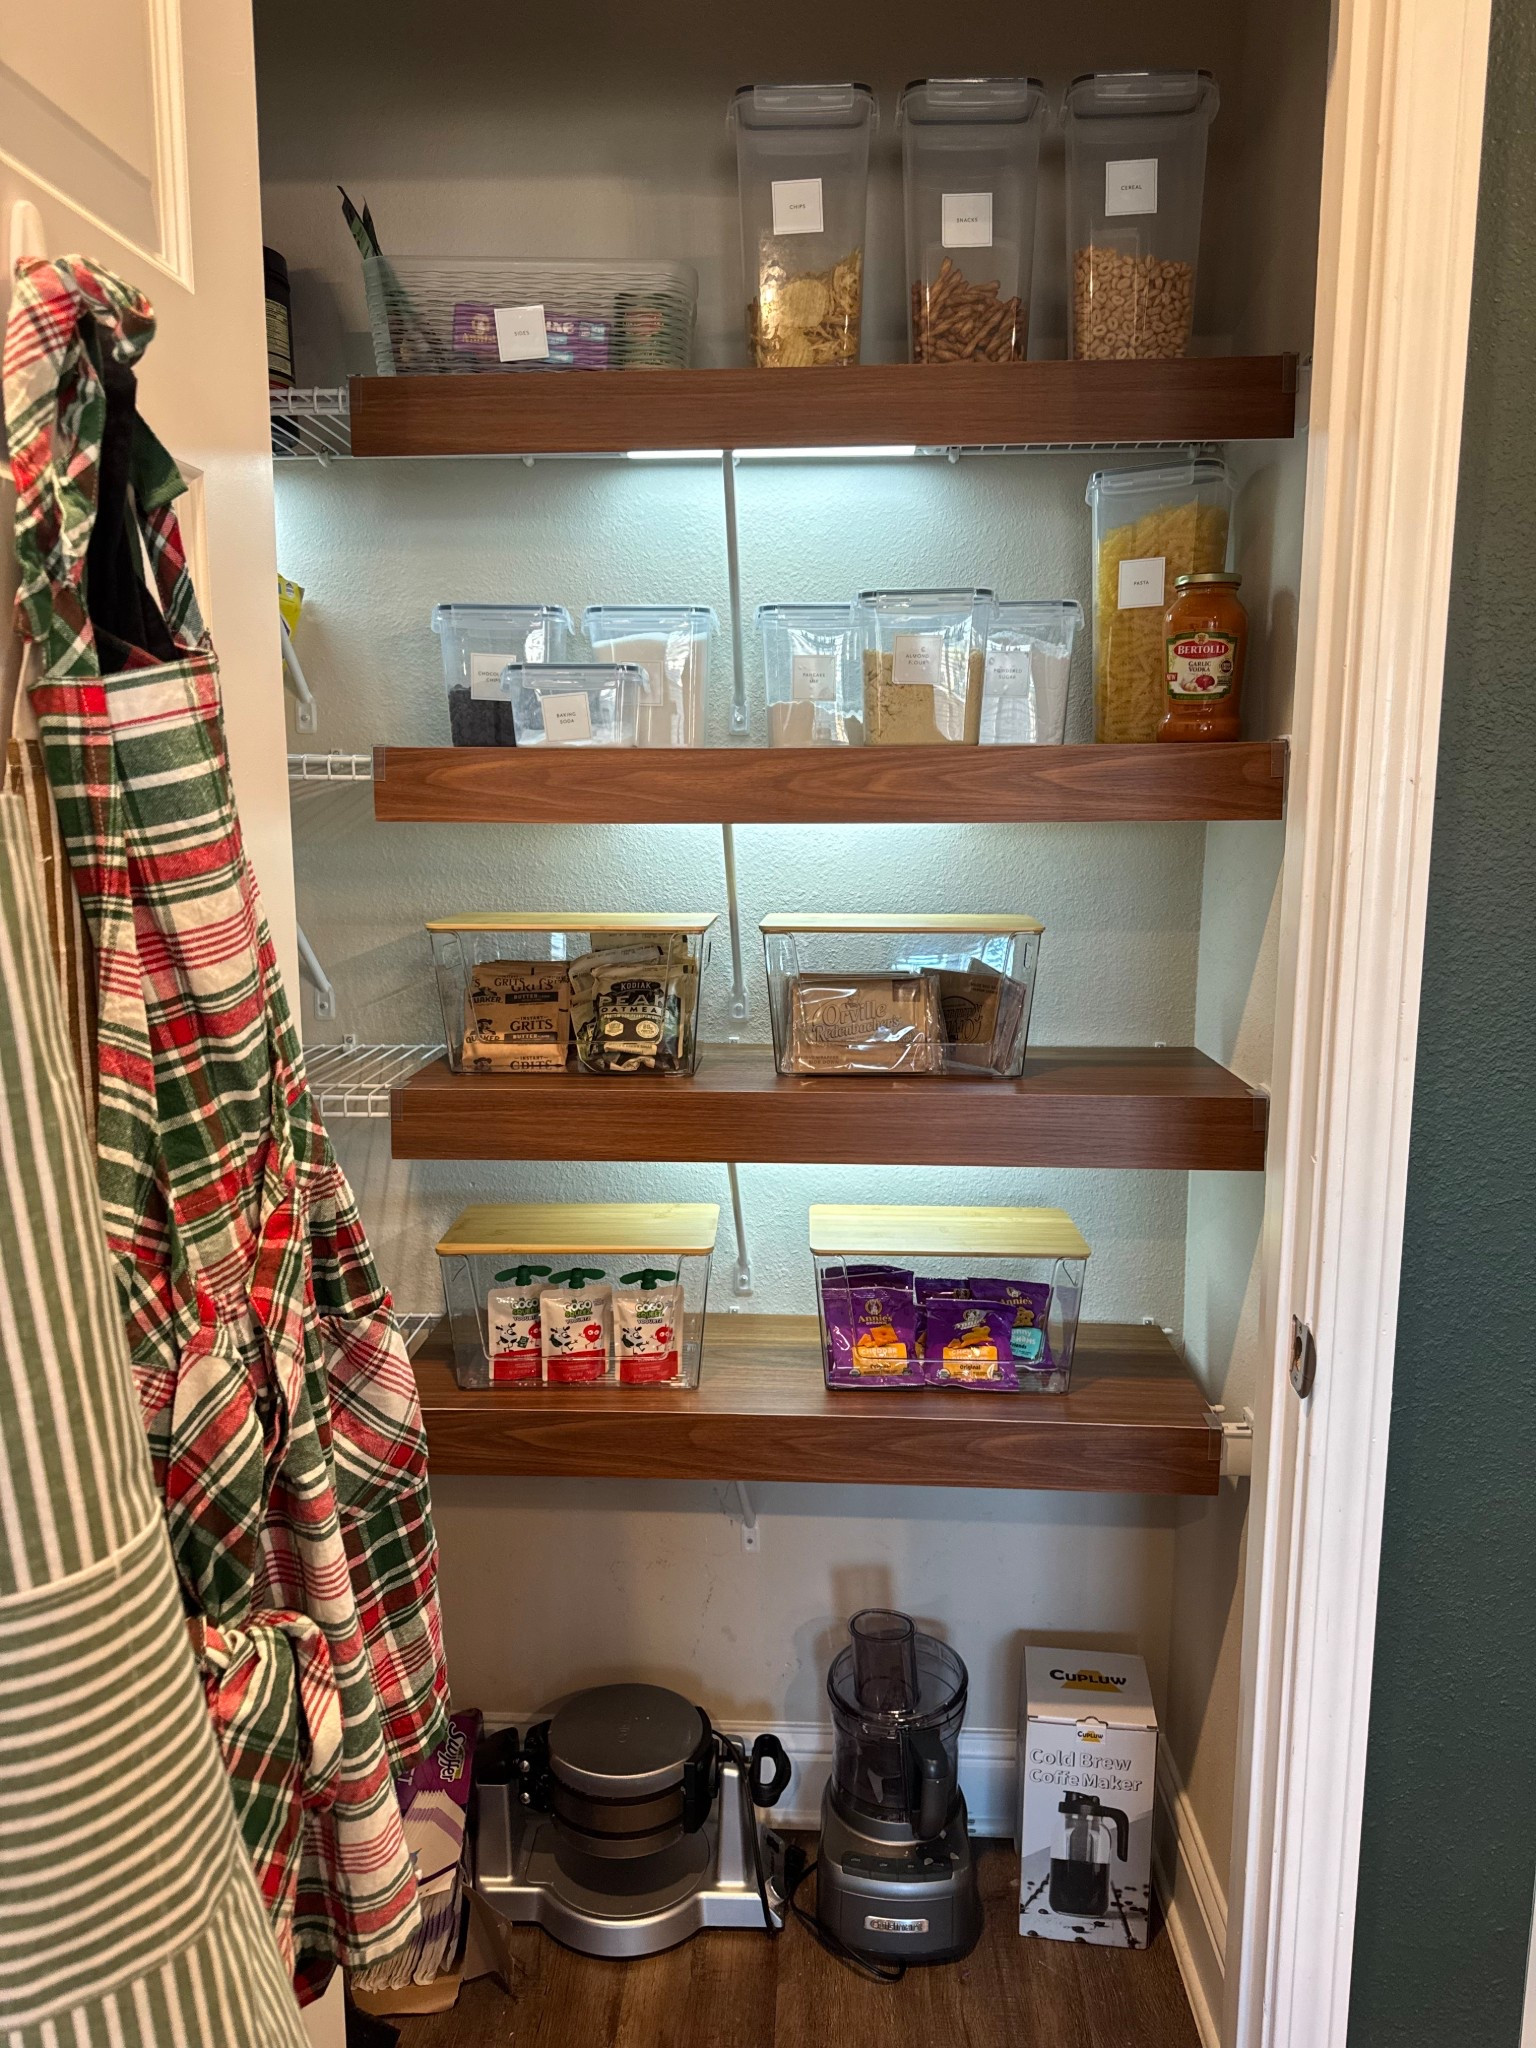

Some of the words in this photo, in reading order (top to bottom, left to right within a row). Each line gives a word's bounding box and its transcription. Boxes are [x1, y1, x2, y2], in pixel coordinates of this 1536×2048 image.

[1177, 645, 1225, 655] BERTOLLI
[620, 982, 652, 991] KODIAK
[822, 999, 888, 1026] Orville
[509, 1019, 553, 1032] GRITS
[511, 1298, 539, 1309] GOGO
[564, 1301, 592, 1312] GOGO
[1000, 1297, 1033, 1305] Annie's
[635, 1302, 664, 1312] GOGO
[858, 1314, 892, 1323] Annie's
[437, 1721, 467, 1783] Swiffer
[1029, 1748, 1076, 1768] Cold
[1078, 1751, 1132, 1772] Brew
[1029, 1769, 1079, 1787] Coffe
[1081, 1771, 1143, 1792] Maker
[870, 1919, 924, 1932] Cuisinart
